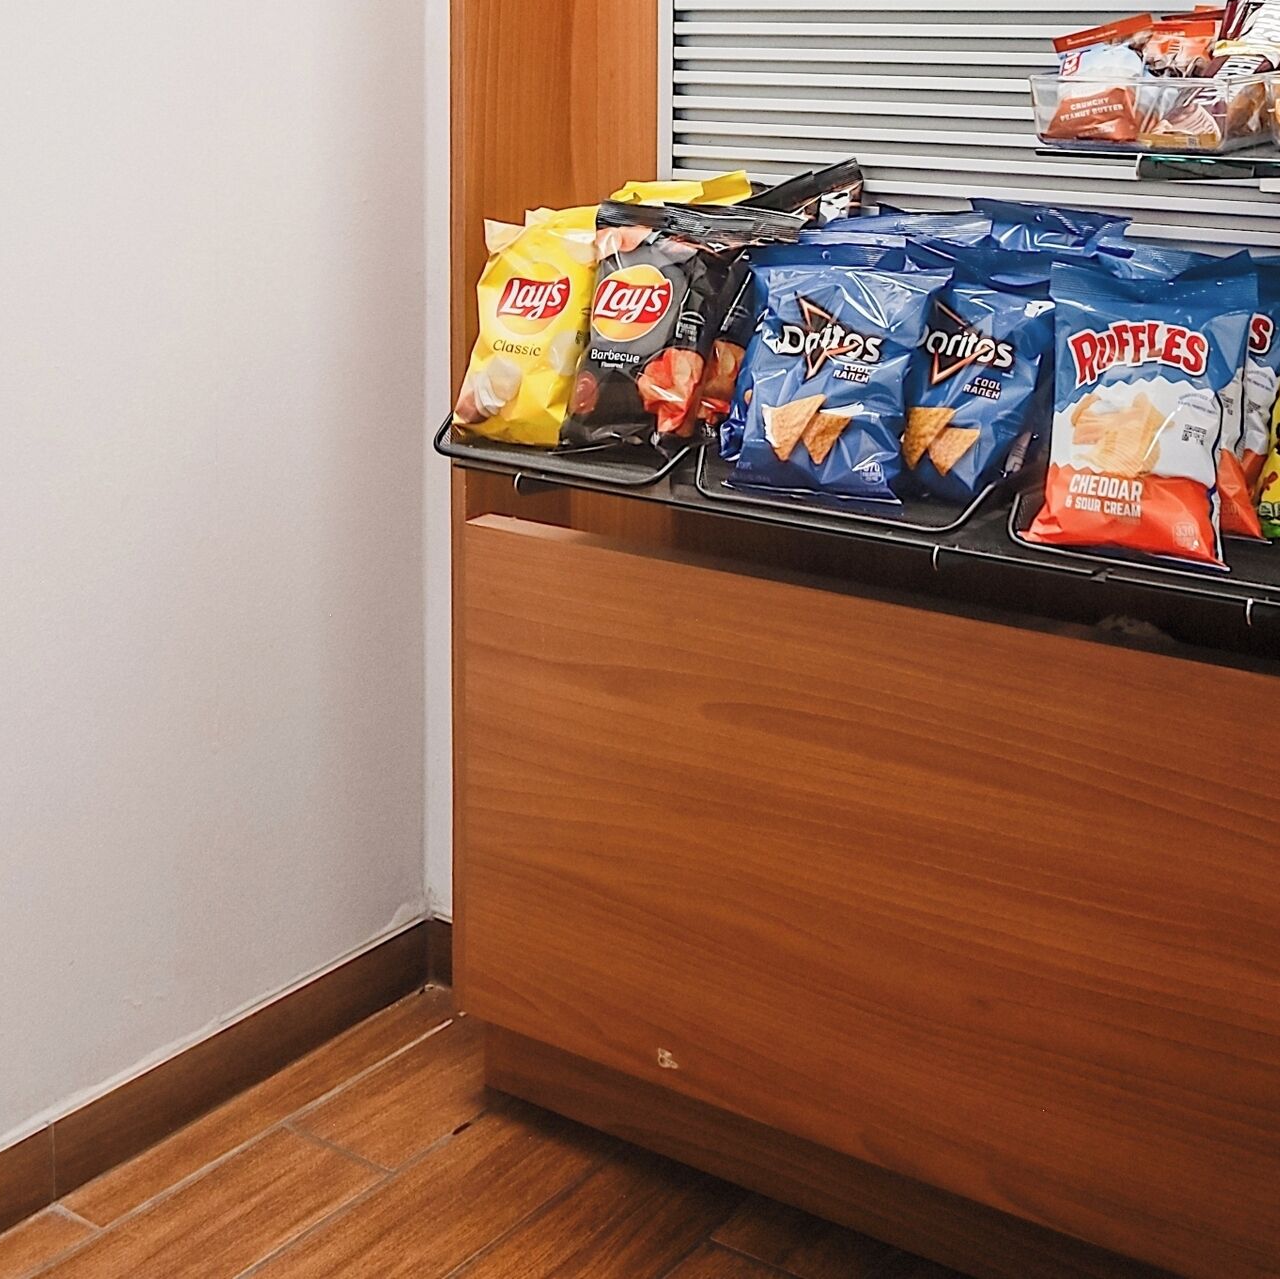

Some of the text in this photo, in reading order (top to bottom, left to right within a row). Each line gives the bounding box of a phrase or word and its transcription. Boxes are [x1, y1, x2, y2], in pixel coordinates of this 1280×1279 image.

[1060, 103, 1124, 122] PEANUT BUTTER
[1070, 97, 1110, 111] CRUNCHY
[500, 278, 567, 320] Lay's
[594, 281, 668, 324] Lay's
[492, 339, 542, 357] Classic
[781, 323, 883, 363] Doritos
[591, 348, 640, 364] Barbecue
[1070, 322, 1208, 387] RUFFLES
[833, 369, 870, 384] RANCH
[974, 376, 1001, 391] COOL
[963, 384, 1000, 400] RANCH
[1069, 474, 1143, 503] CHEDDAR
[1065, 496, 1142, 518] & SOUR CREAM
